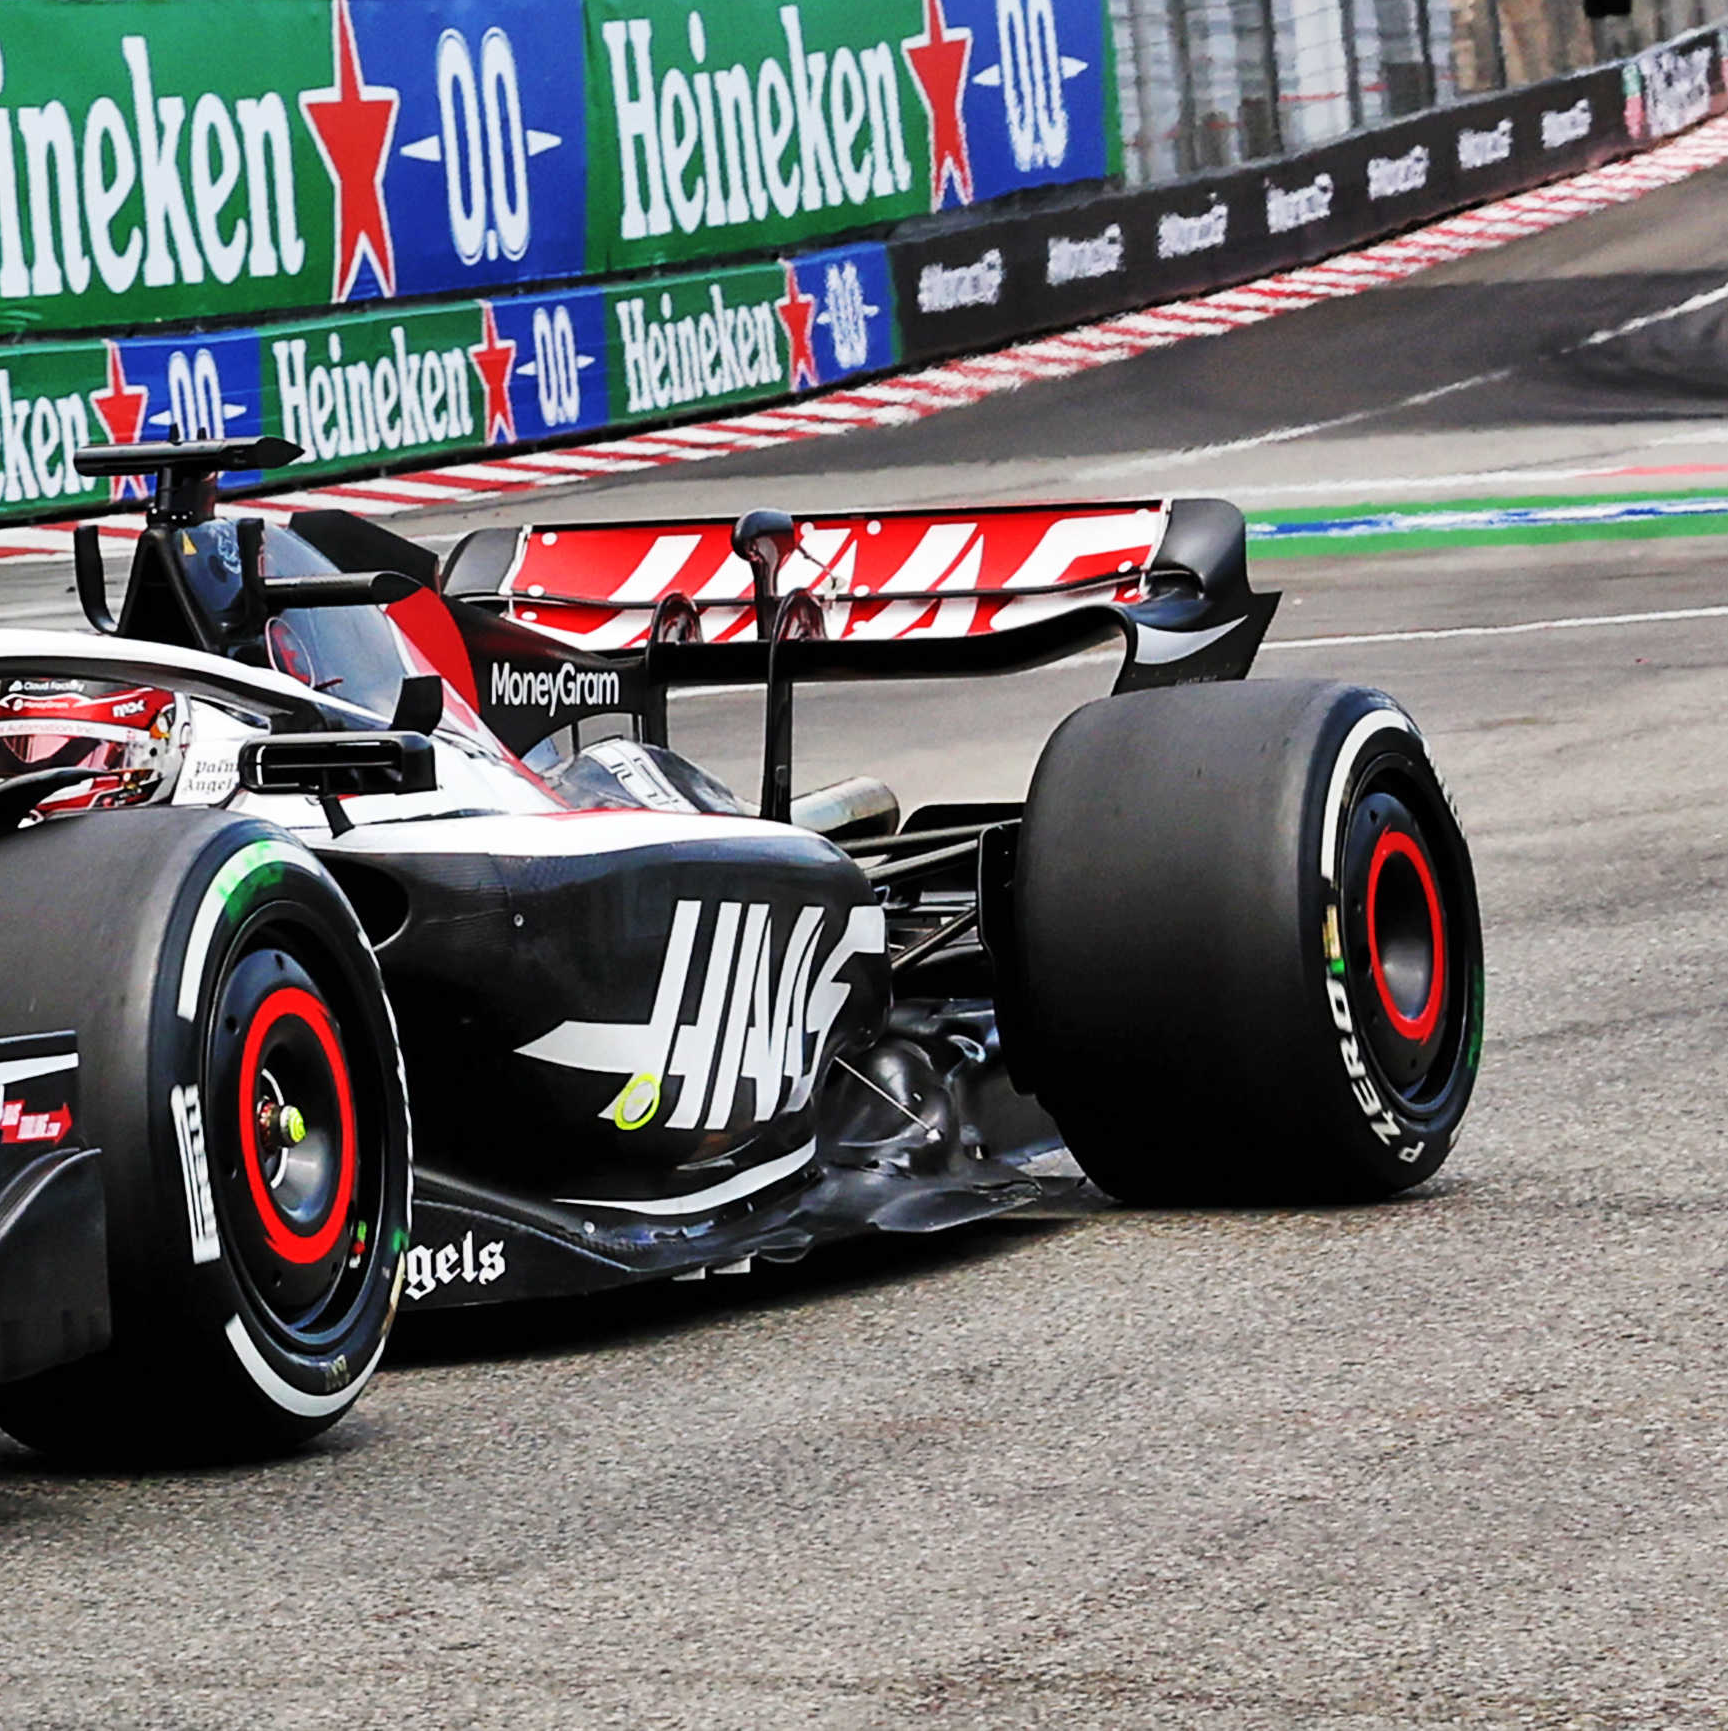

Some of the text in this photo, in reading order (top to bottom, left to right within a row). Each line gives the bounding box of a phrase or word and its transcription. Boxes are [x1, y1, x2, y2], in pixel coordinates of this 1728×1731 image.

[435, 26, 531, 267] 0.0
[602, 5, 912, 240] Heineken
[273, 304, 579, 465] Heineken 0.0
[615, 284, 782, 414] Heineken
[7, 722, 73, 735] Automation
[24, 681, 49, 691] Cloud
[491, 661, 620, 717] MoneyGram
[181, 777, 238, 795] Angel
[515, 900, 886, 1131] HAAS
[1325, 976, 1403, 1146] ZERO
[404, 1229, 505, 1300] gels
